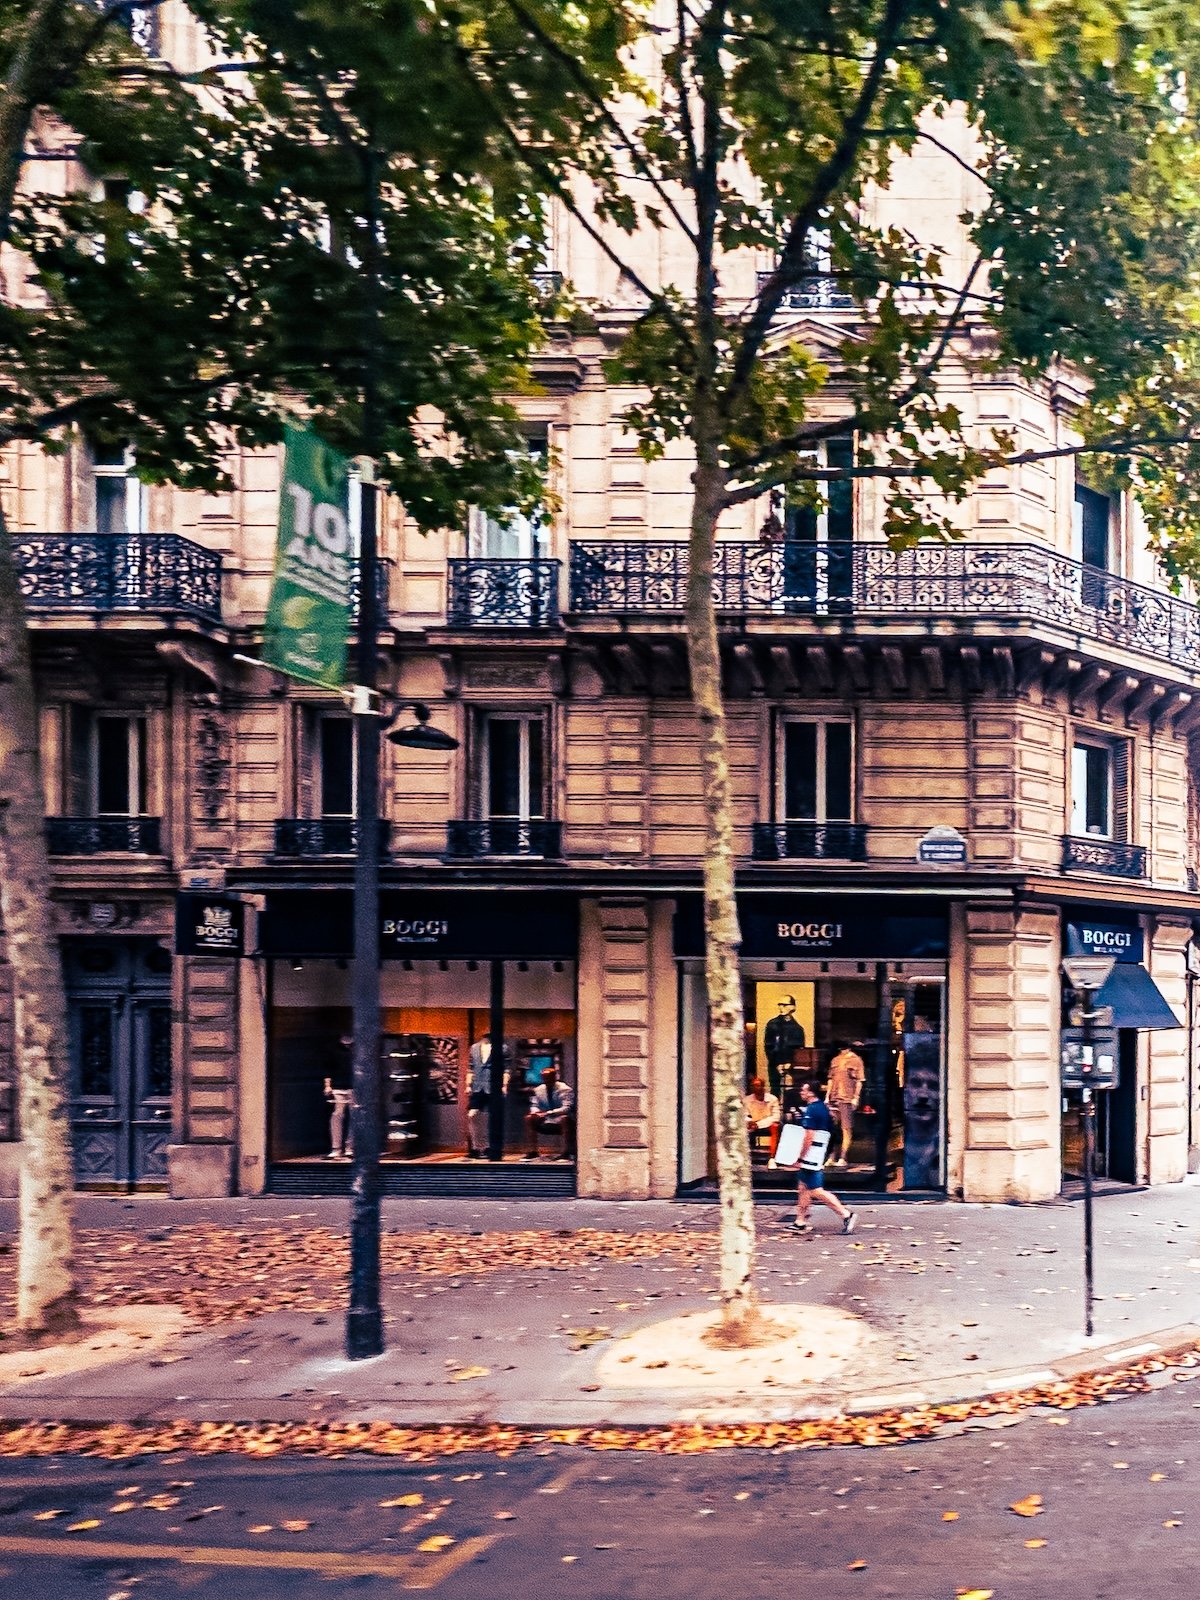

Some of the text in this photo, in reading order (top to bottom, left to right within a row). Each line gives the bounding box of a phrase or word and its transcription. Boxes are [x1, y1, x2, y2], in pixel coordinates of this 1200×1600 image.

[195, 925, 239, 938] BOGGI
[382, 919, 449, 934] BOGGI
[776, 922, 843, 938] BOGGI
[1082, 929, 1132, 947] BOGGI
